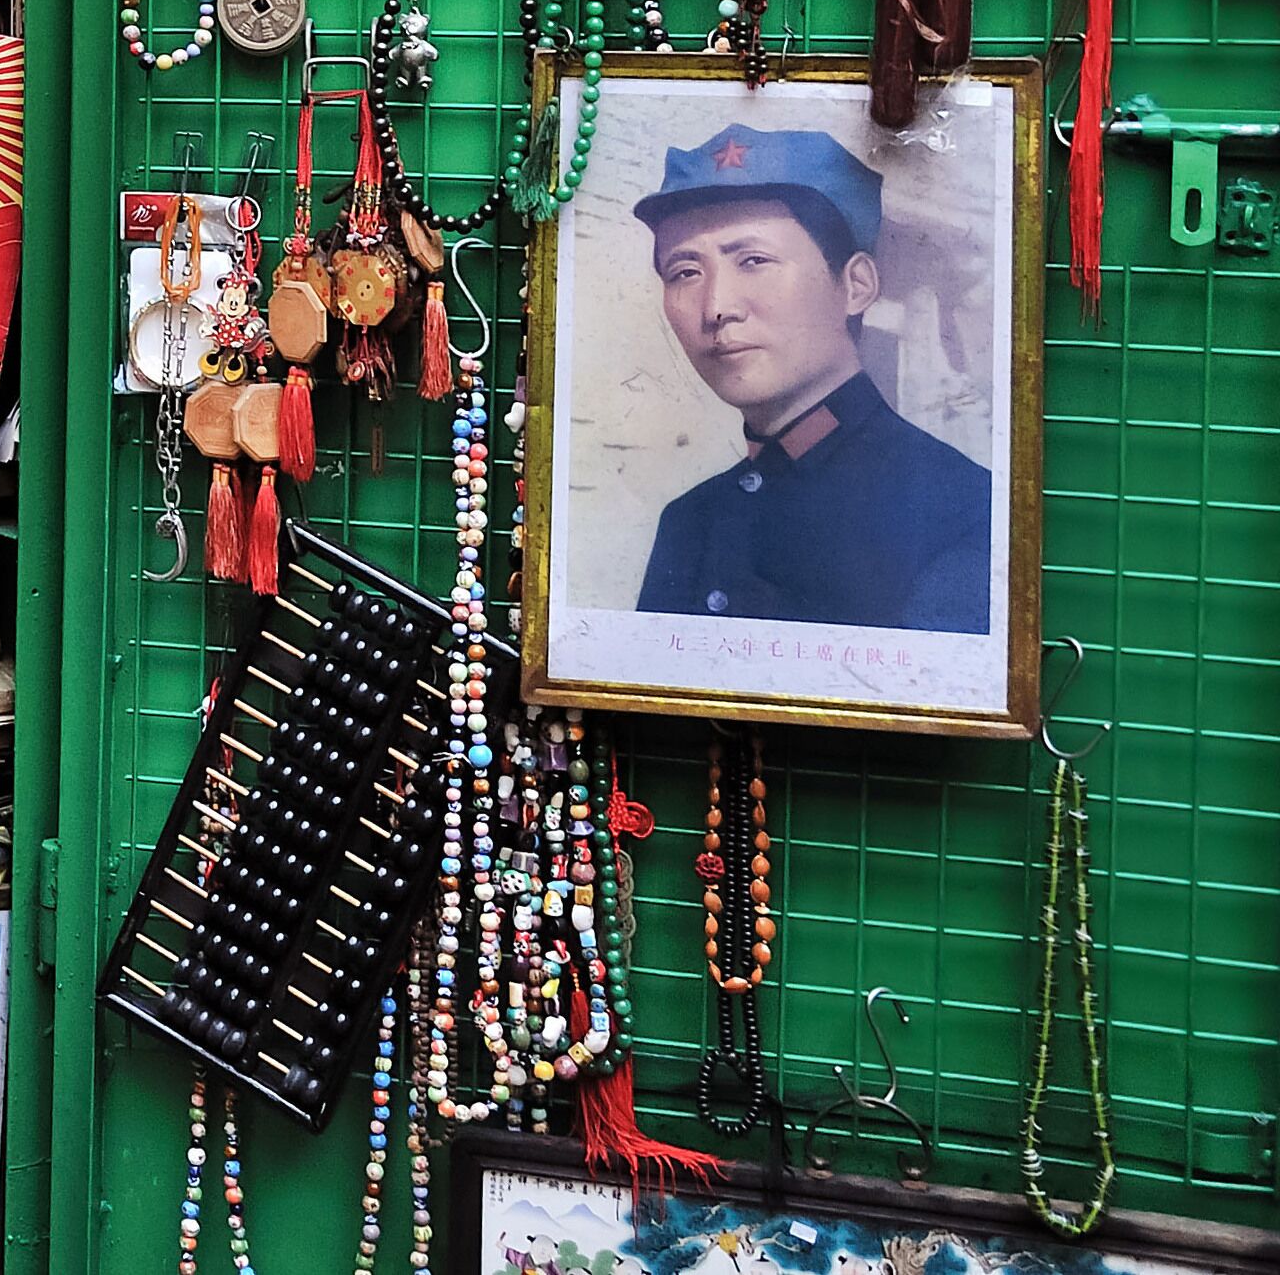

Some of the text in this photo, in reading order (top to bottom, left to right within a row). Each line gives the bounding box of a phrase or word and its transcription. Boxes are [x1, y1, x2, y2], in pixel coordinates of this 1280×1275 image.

[642, 633, 913, 666] 一九三六年毛主席在陕北
